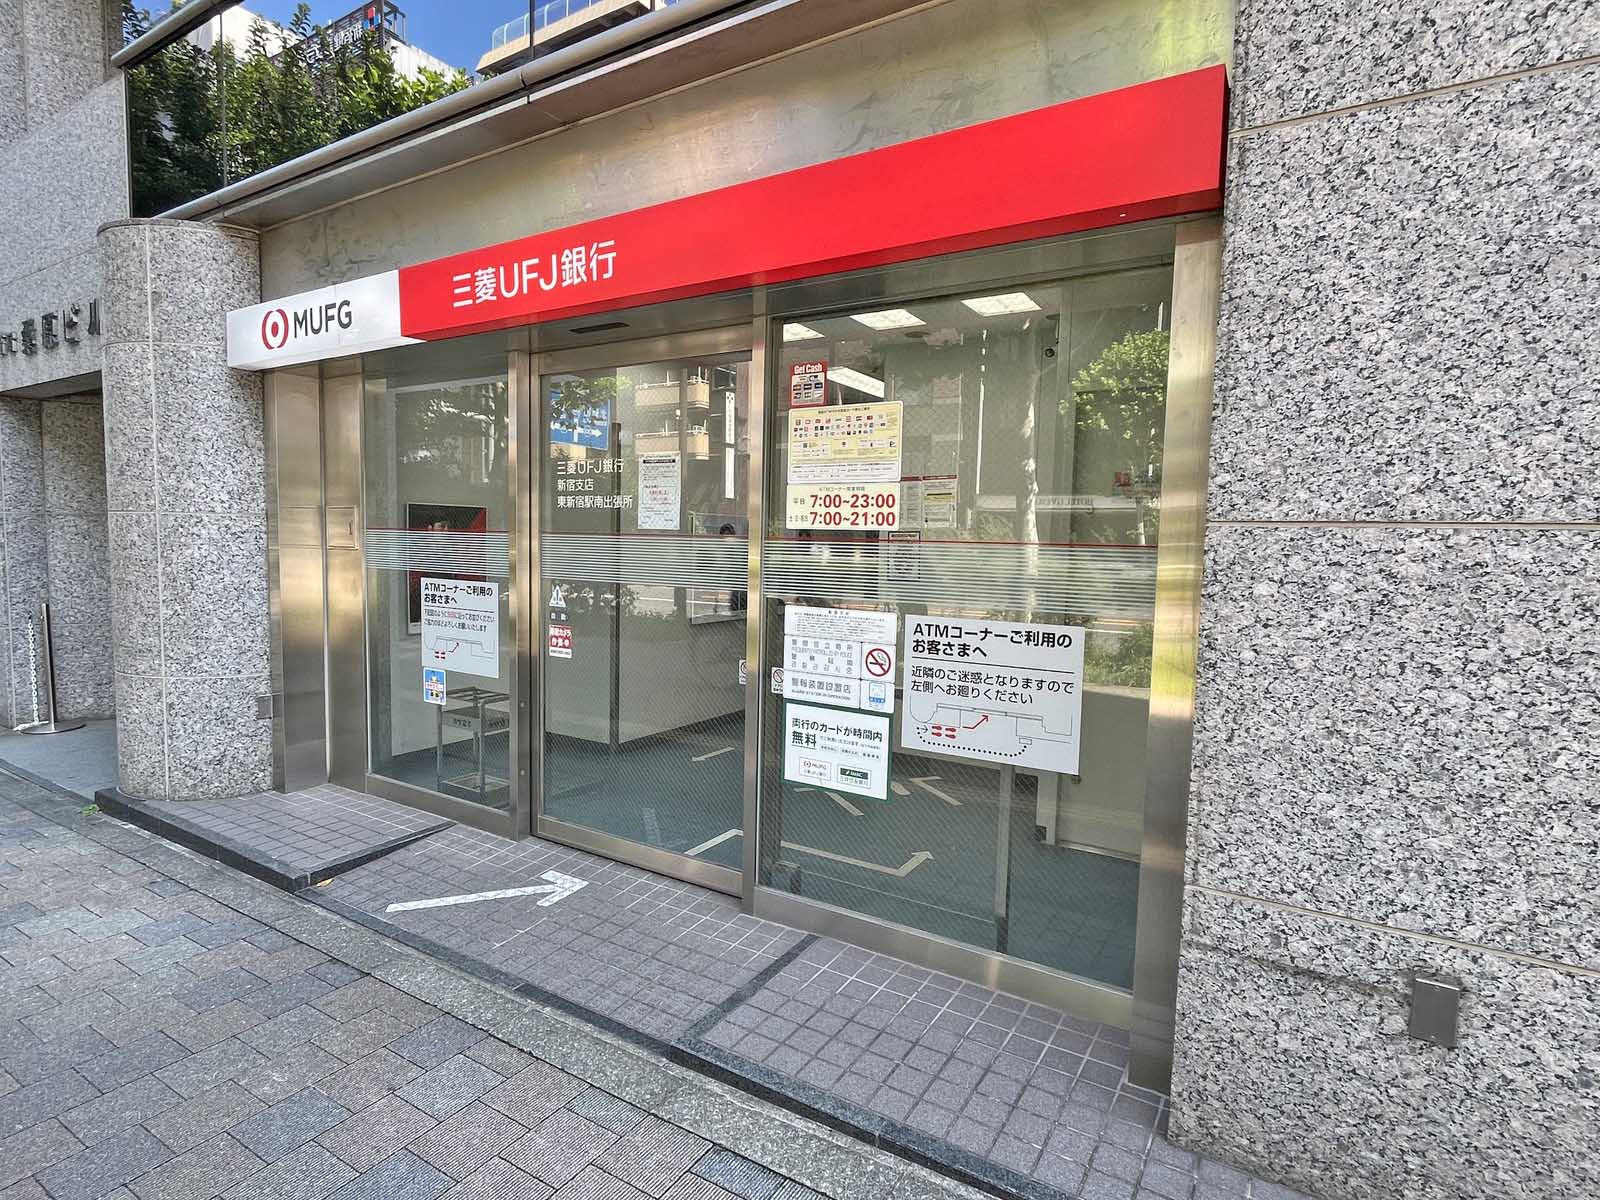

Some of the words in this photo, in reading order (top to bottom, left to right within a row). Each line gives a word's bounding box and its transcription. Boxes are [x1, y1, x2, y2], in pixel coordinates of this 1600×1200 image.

[452, 239, 617, 308] 三菱UFJ銀行
[293, 300, 353, 339] MUFG
[794, 365, 806, 374] Get
[806, 363, 823, 373] Cash
[556, 459, 625, 476] 三菱UFJ銀行
[557, 478, 594, 492] 新宿支店
[556, 495, 633, 509] 東新宿駅南出張所
[423, 593, 458, 605] お客さまへ
[424, 582, 494, 598] ATMコーナーご利用の
[913, 622, 1073, 649] ATMコーナーご利用の
[911, 638, 988, 659] お客さまへ
[911, 665, 1075, 695] 近隣のご迷惑となりますので
[910, 680, 1034, 705] 左側へお廻りください
[791, 717, 883, 743] 両行のカードが時間内
[791, 730, 817, 748] 無料
